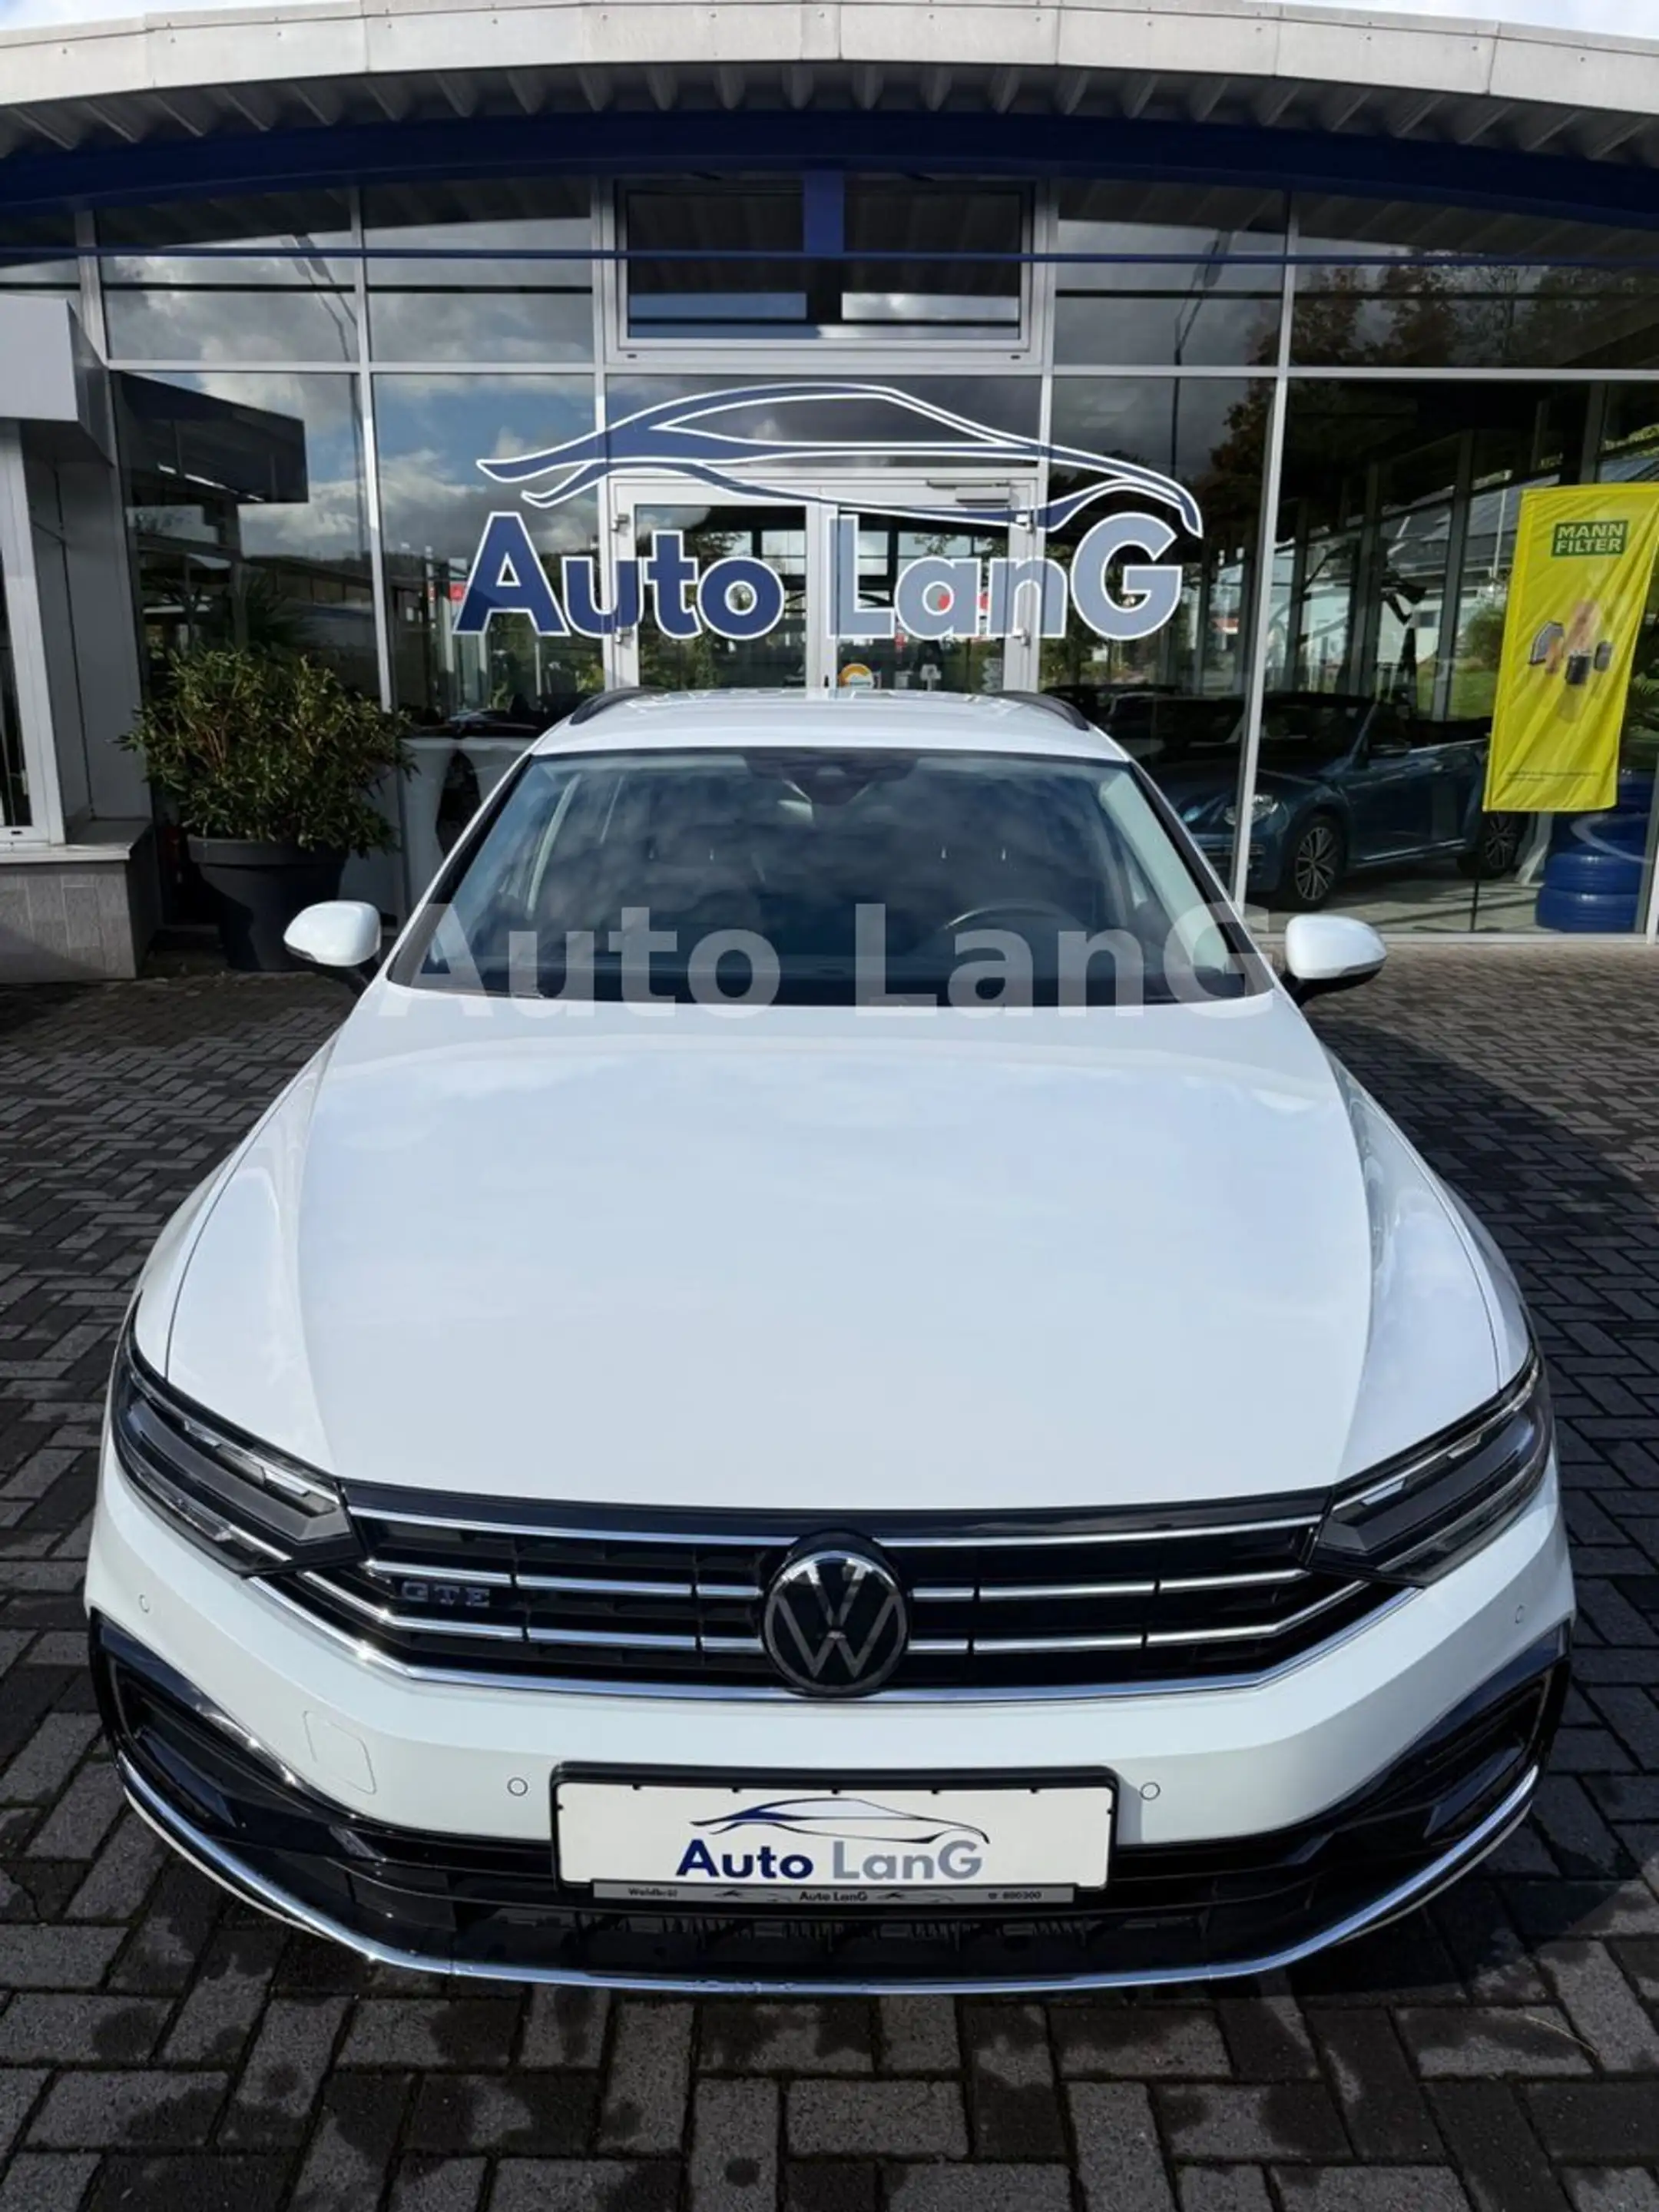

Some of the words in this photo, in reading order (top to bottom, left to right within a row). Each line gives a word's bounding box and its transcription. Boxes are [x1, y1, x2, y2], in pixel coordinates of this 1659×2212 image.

[1557, 523, 1624, 538] MANN
[1555, 538, 1621, 553] FILTER
[453, 512, 785, 637] Auto
[827, 512, 1182, 640] LanG
[401, 1581, 490, 1607] GTE
[676, 1839, 813, 1879] Auto
[833, 1839, 982, 1880] LanG
[799, 1891, 830, 1902] Auto
[833, 1891, 868, 1902] LanG
